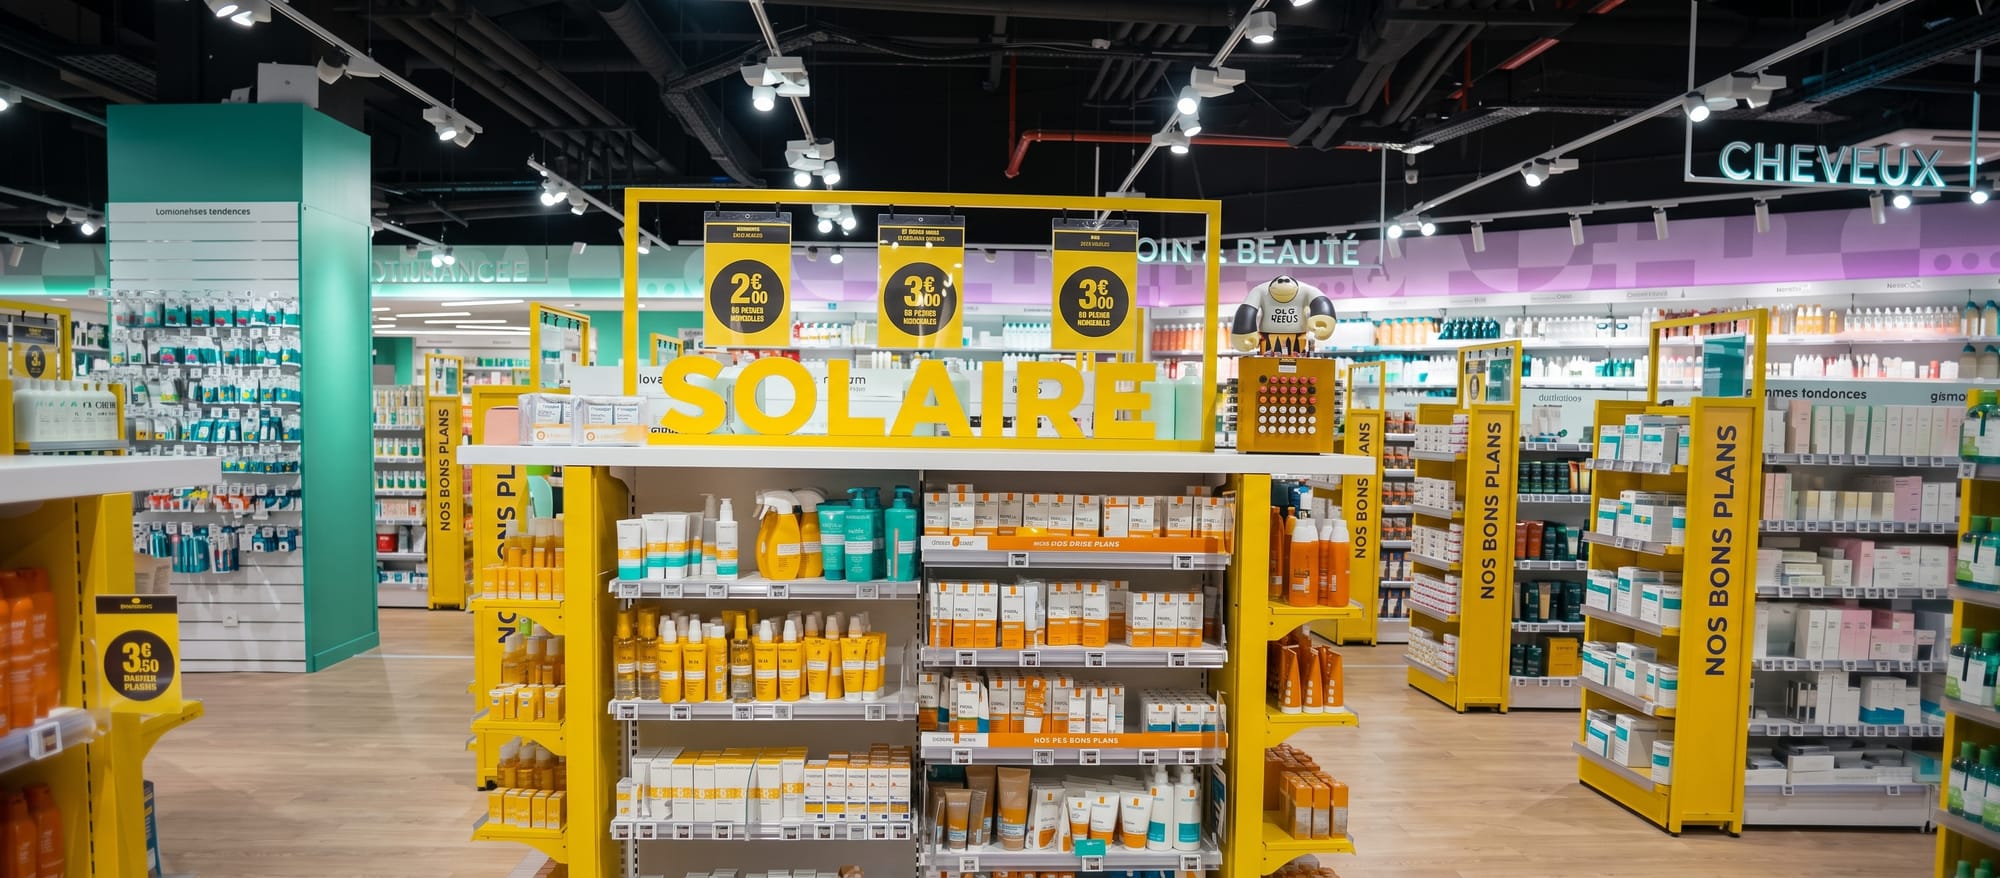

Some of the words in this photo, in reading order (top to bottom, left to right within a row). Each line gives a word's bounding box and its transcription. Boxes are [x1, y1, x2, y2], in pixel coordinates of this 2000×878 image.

[1718, 141, 1946, 188] CHEVEUX
[1237, 232, 1360, 265] BEAUTÉ
[660, 355, 1157, 440] SOLAIRE
[438, 408, 449, 454] PLANS
[439, 458, 450, 498] BONS
[1484, 422, 1502, 488] PLANS
[1712, 424, 1738, 518] PLANS
[440, 501, 451, 531] NOS
[1356, 477, 1369, 521] BONS
[1482, 494, 1499, 550] BONS
[1354, 526, 1367, 559] NOS
[1480, 558, 1497, 599] NOS
[1708, 527, 1733, 606] BONS
[1705, 615, 1729, 676] NOS
[1033, 737, 1050, 745] NOS
[1093, 737, 1120, 745] PLANS
